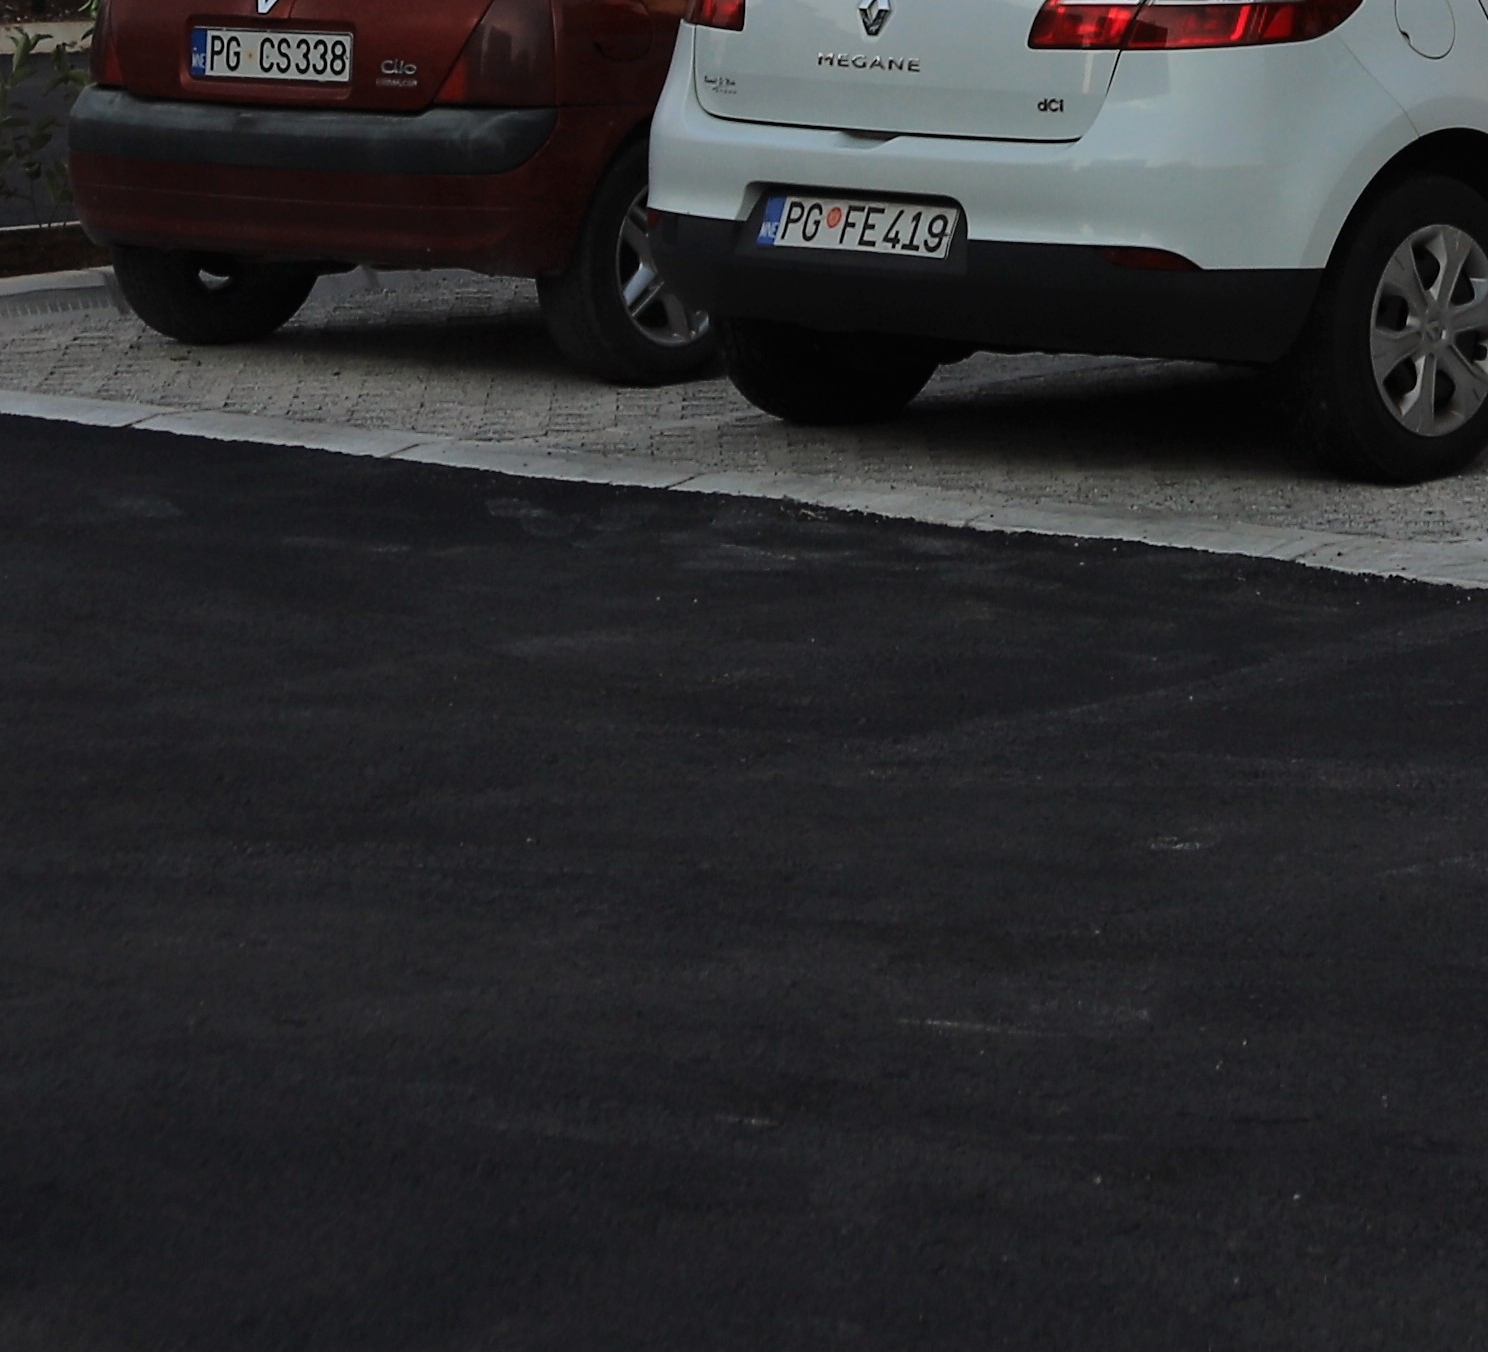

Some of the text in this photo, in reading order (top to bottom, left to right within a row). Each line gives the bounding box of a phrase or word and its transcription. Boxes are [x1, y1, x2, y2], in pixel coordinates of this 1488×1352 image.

[210, 35, 241, 72] PG
[259, 37, 348, 76] CS338
[817, 52, 921, 73] MEGANE
[380, 58, 417, 75] Clio
[1037, 98, 1064, 113] dCi
[760, 201, 949, 253] MNE PG FE419
